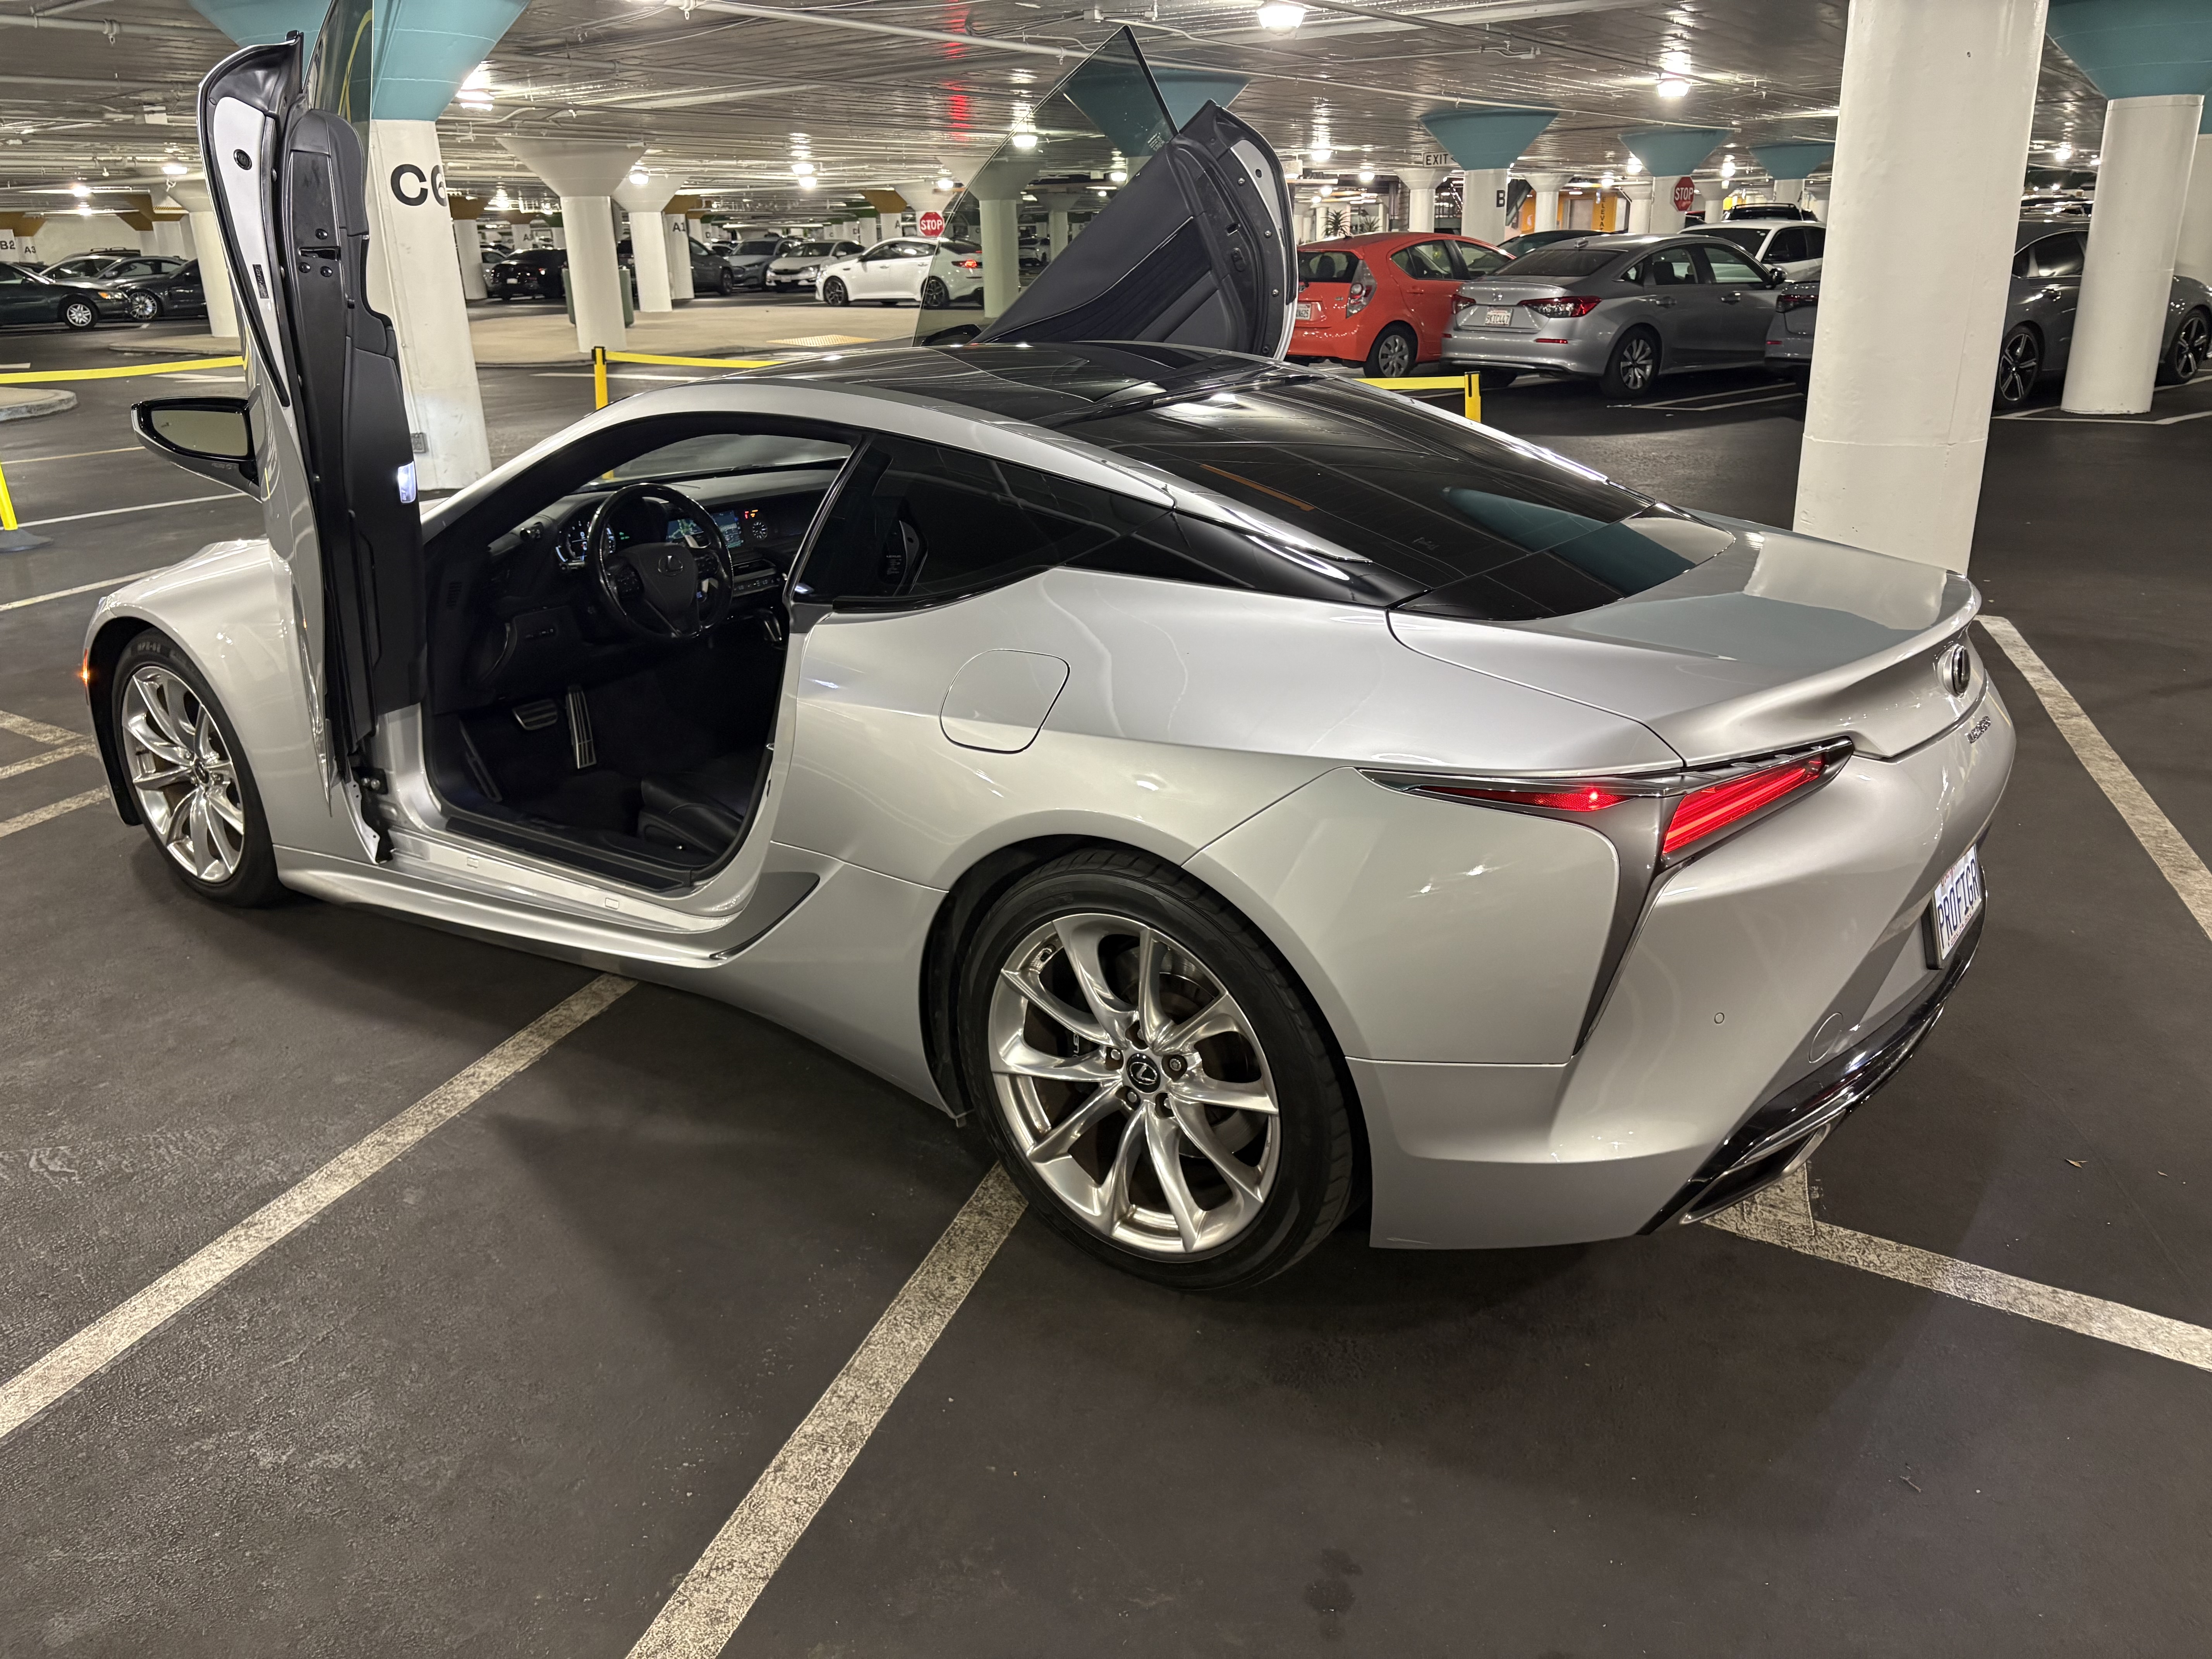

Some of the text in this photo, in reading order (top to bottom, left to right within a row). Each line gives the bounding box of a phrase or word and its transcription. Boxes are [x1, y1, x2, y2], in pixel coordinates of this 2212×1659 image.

[1426, 154, 1448, 165] EXIT
[390, 164, 447, 207] C6
[1496, 190, 1505, 207] B
[1675, 187, 1693, 201] STOP
[921, 219, 943, 230] STOP
[0, 240, 15, 250] B2
[1937, 859, 1979, 949] PROFIGR
